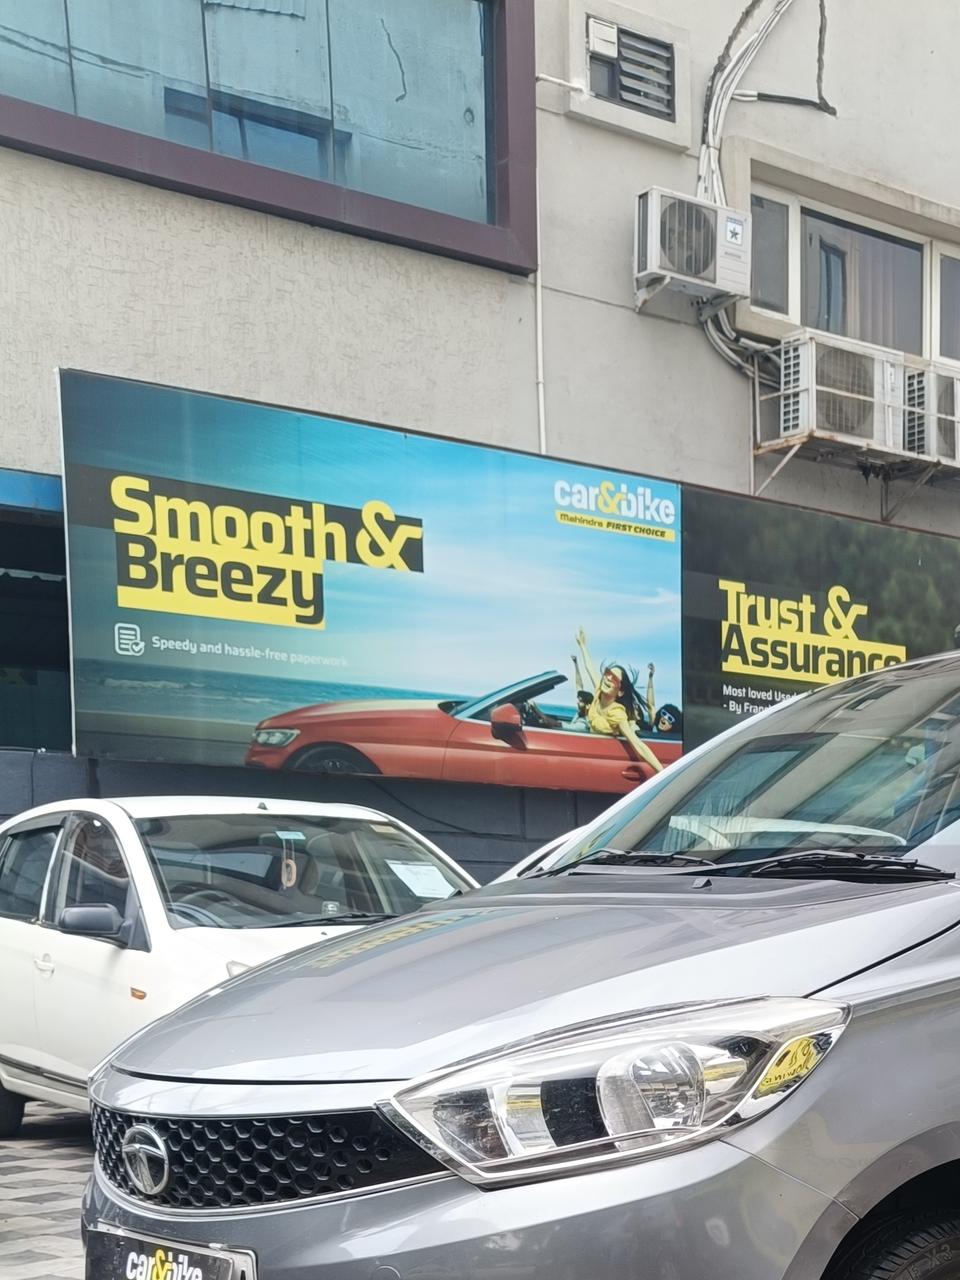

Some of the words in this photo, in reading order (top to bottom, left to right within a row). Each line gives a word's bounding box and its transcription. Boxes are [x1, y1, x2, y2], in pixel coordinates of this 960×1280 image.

[554, 480, 675, 524] car&bike
[111, 475, 347, 562] Smooth
[355, 500, 423, 571] &
[606, 521, 633, 533] FIRST
[633, 525, 666, 538] CHOICE
[116, 532, 324, 625] Breezy
[719, 579, 816, 632] Trust
[823, 585, 868, 640] &
[151, 636, 197, 654] Speedy
[199, 642, 222, 655] and
[224, 644, 289, 662] hassle-free
[722, 684, 746, 697] Most
[748, 686, 773, 700] loved
[729, 701, 742, 714] By
